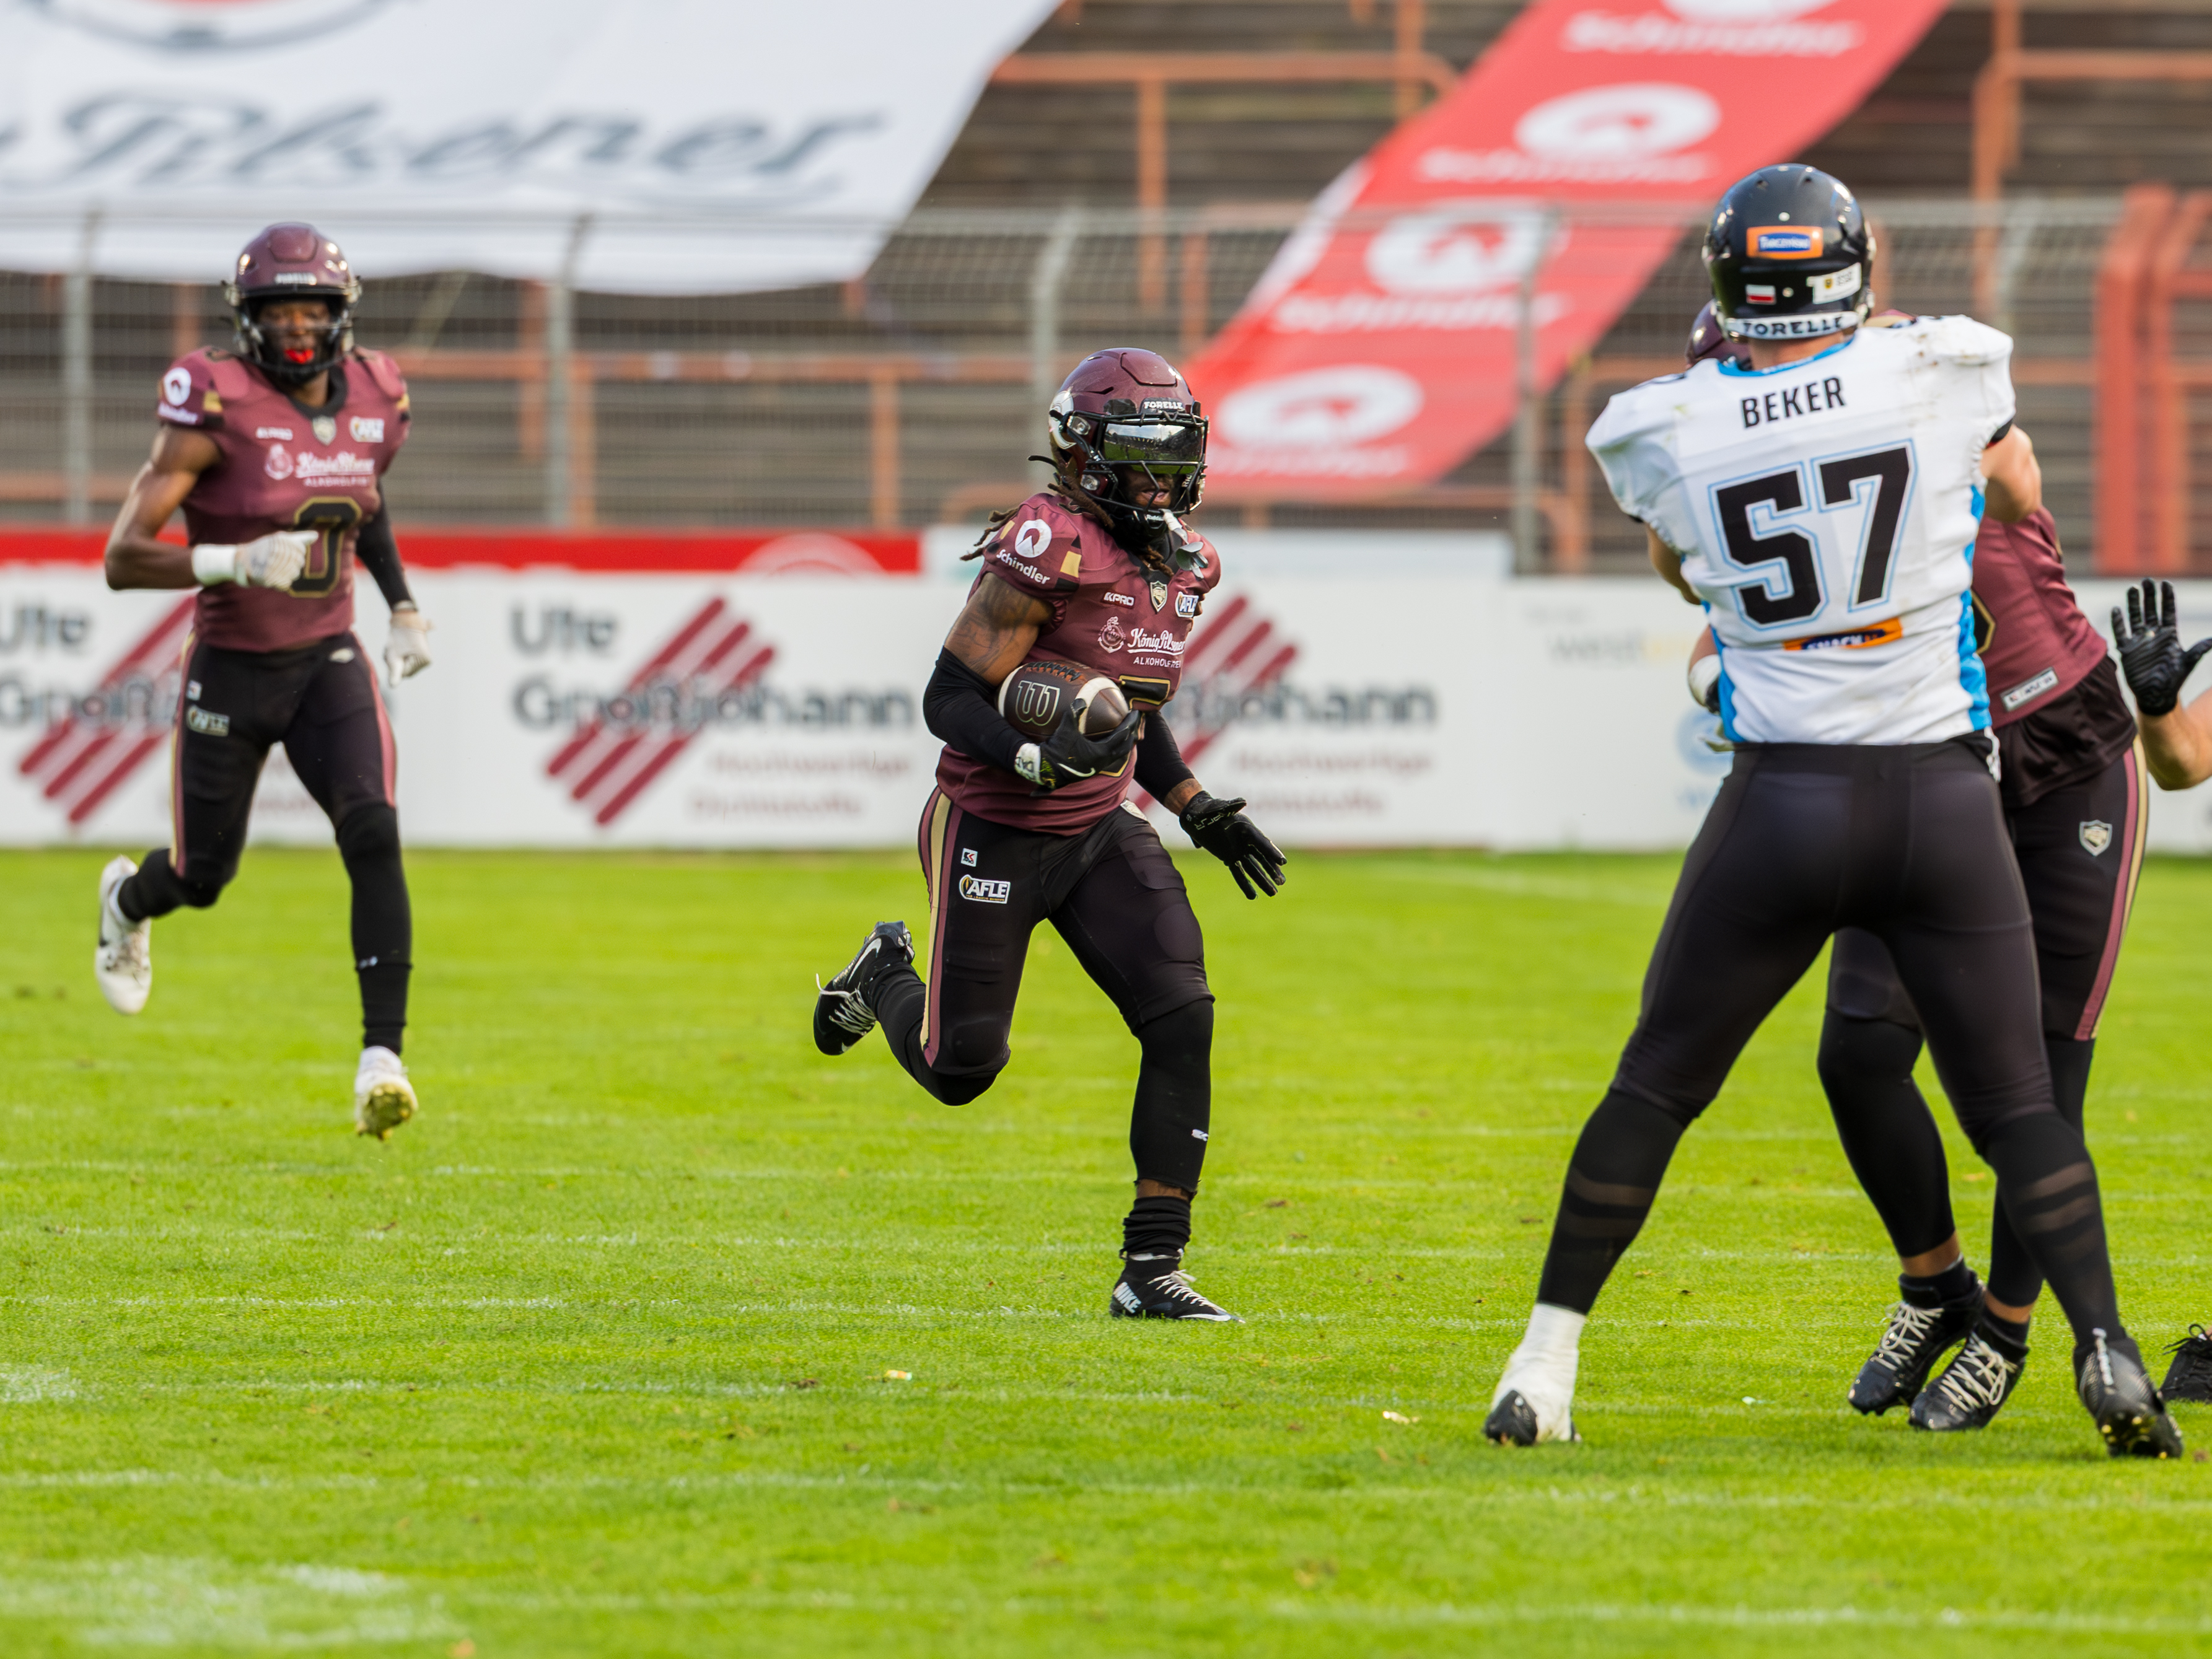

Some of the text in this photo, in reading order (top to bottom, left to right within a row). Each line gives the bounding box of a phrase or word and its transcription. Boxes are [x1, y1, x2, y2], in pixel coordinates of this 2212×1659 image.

[1144, 400, 1183, 409] FORELLE
[1742, 376, 1846, 429] BEKER
[1708, 438, 1918, 631] 57
[996, 549, 1051, 584] Schindler
[509, 600, 617, 654] Ute
[1127, 628, 1160, 652] König
[1016, 680, 1060, 726] W
[966, 880, 1007, 898] AFLE
